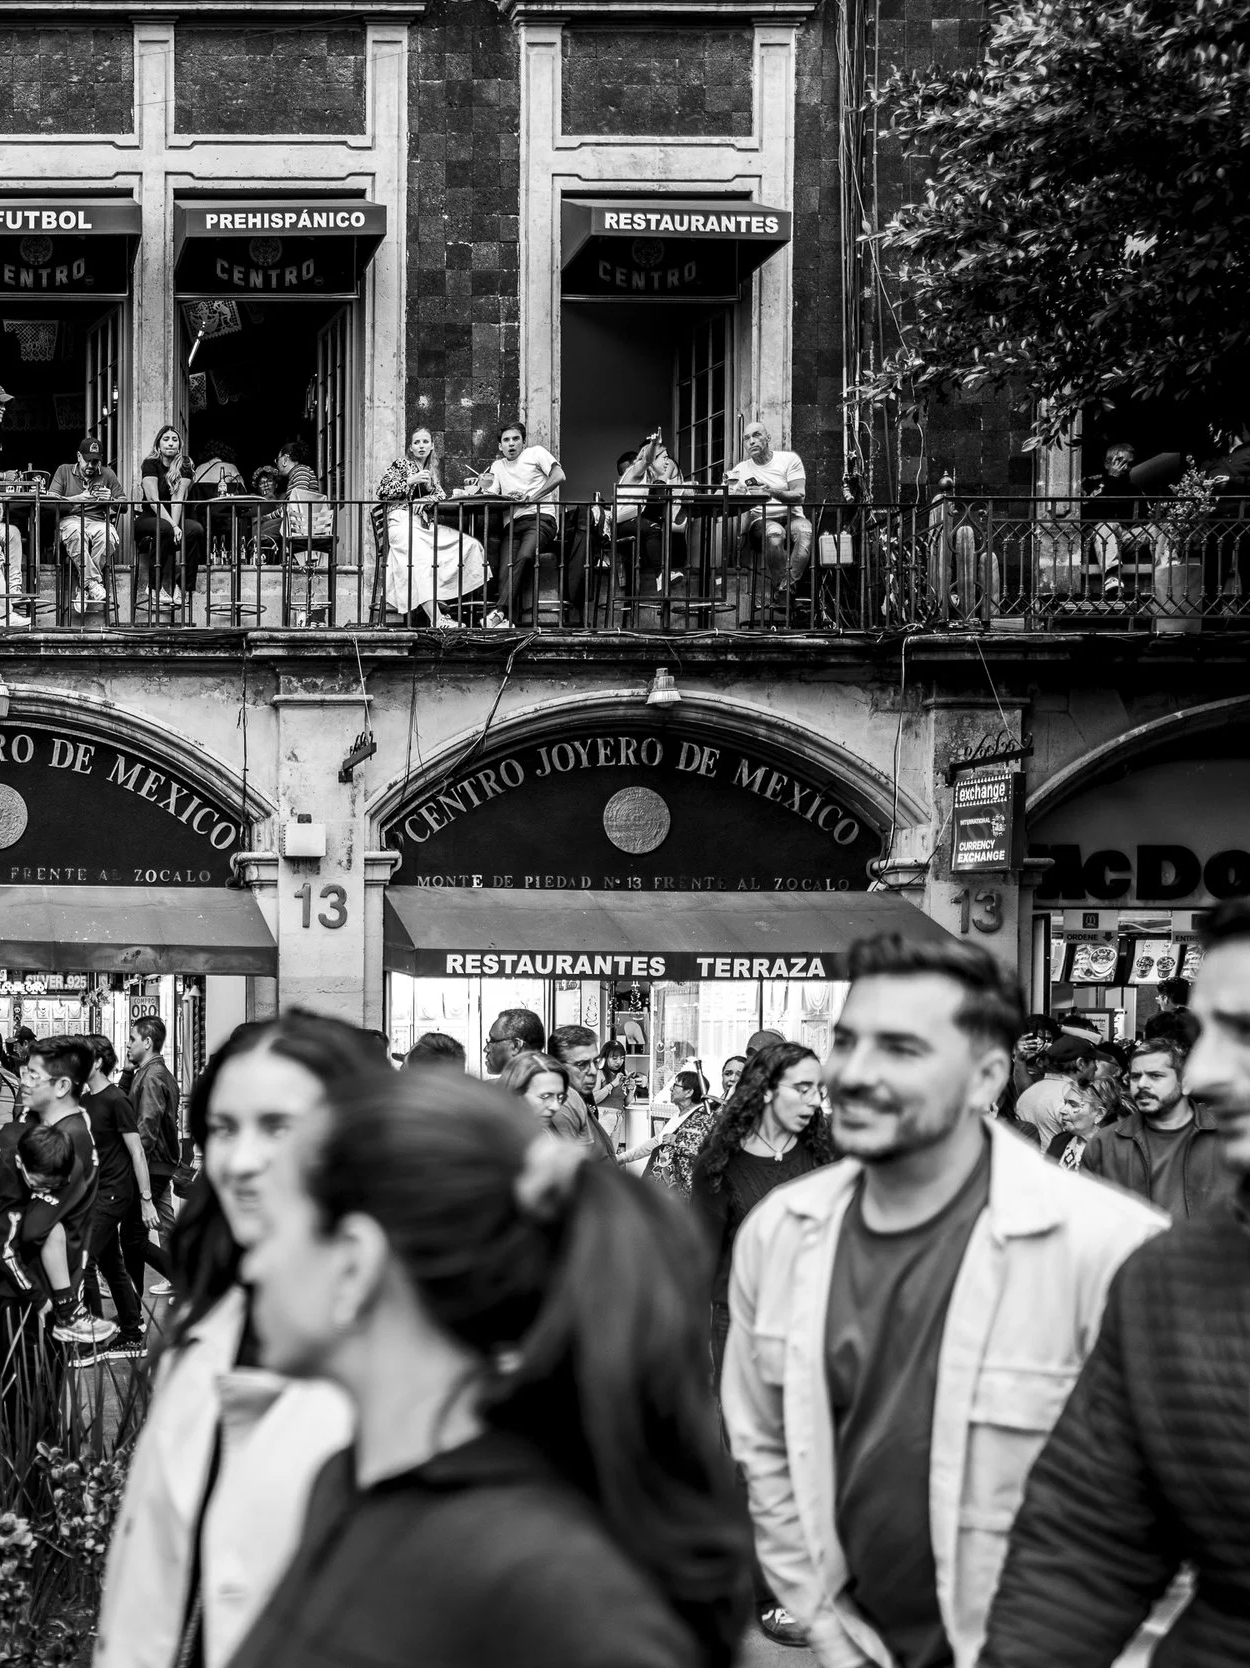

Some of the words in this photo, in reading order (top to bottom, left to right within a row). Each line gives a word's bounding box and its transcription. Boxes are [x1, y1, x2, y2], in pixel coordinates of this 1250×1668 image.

[205, 209, 366, 230] PREHISPÁNICO
[604, 212, 779, 234] RESTAURANTES
[216, 257, 315, 289] CENTRO
[598, 260, 697, 290] CENTRO
[49, 738, 94, 775] DE
[106, 754, 238, 851] MEXICO
[403, 757, 527, 845] CENTRO
[536, 736, 664, 778] JOYERO
[675, 742, 720, 778] DE
[731, 758, 861, 846] MEXICO
[959, 782, 1006, 801] exchange
[959, 840, 996, 852] CURRENCY
[957, 851, 1005, 863] EXCHANGE
[10, 867, 87, 881] FRENTE
[134, 870, 211, 883] ZOCALO
[417, 875, 483, 888] MONTE
[493, 876, 513, 888] DE
[524, 876, 591, 889] PIEDAD
[627, 877, 642, 889] 13
[654, 877, 727, 890] FRENTE
[737, 878, 760, 890] AL
[774, 878, 849, 891] ZOCALO
[294, 883, 348, 928] 13
[950, 888, 1003, 934] 13
[1067, 933, 1099, 941] ORDENE
[446, 953, 665, 977] RESTAURANTES
[697, 957, 826, 978] TERRAZA
[131, 1004, 157, 1018] ORO
